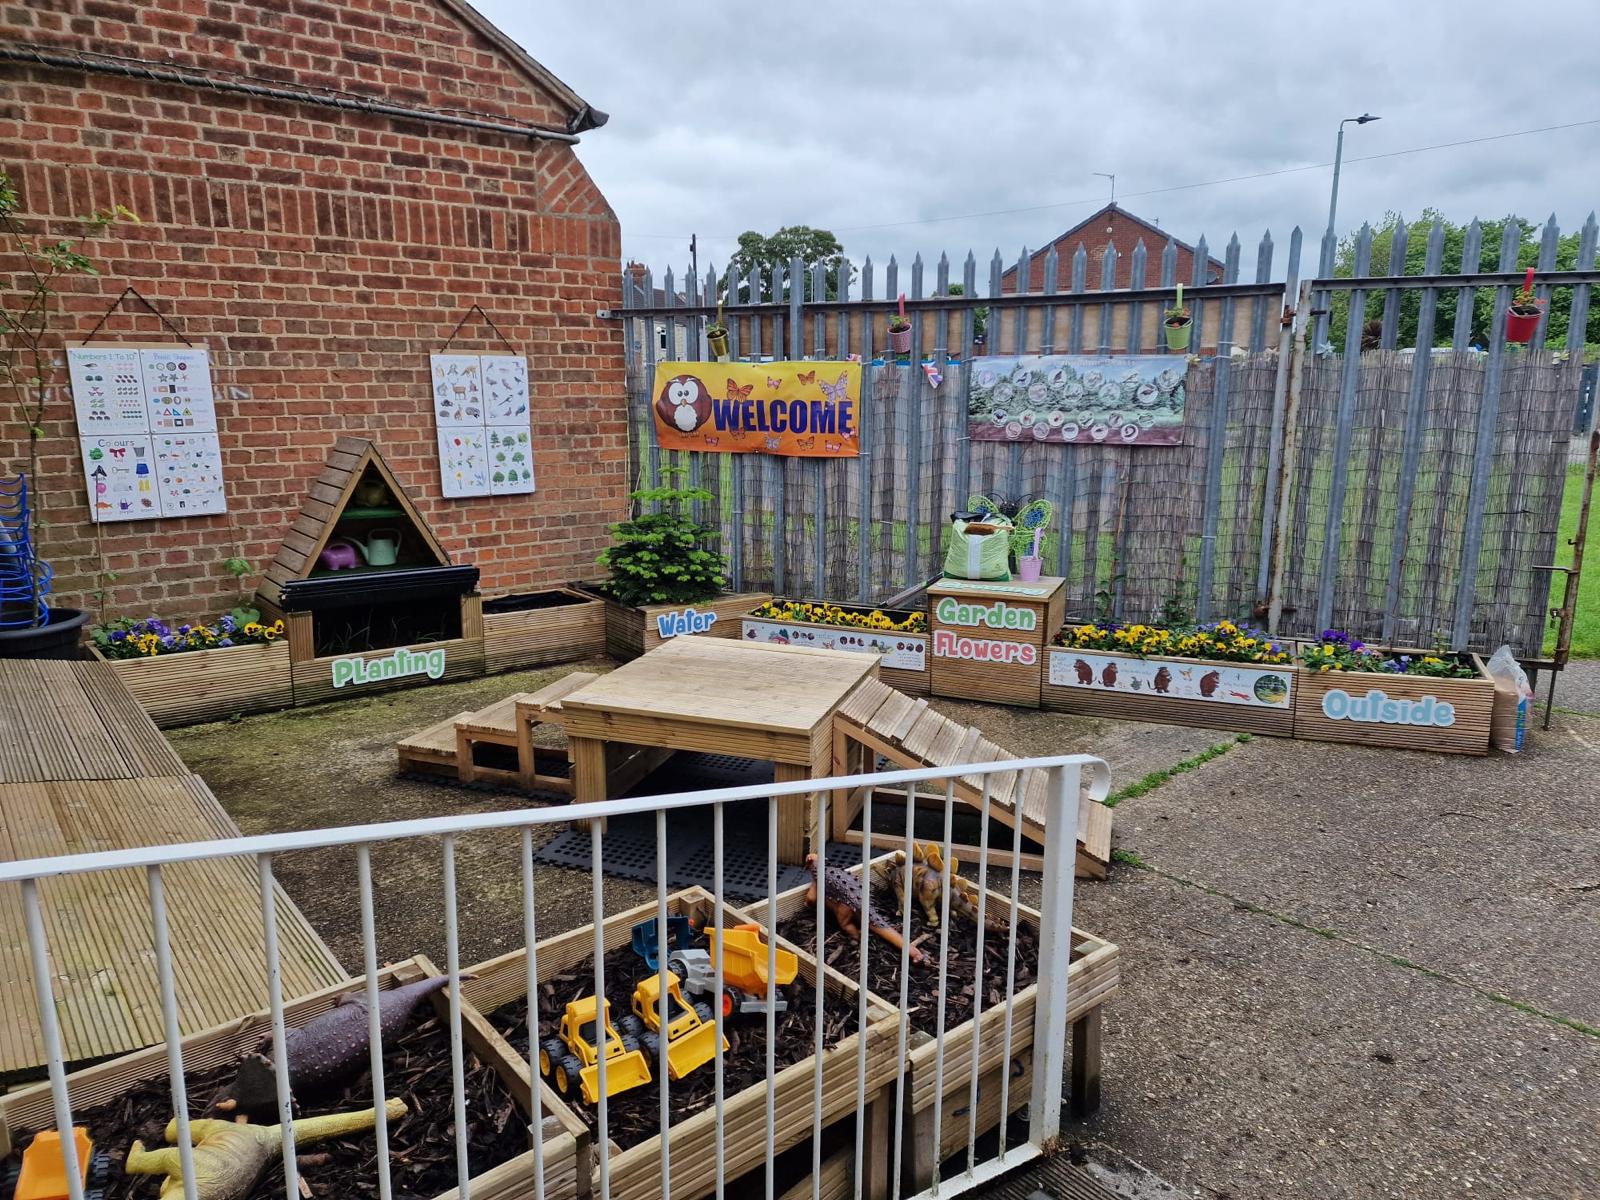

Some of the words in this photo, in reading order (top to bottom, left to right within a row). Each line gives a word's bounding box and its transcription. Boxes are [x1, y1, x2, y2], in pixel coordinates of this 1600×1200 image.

[73, 352, 107, 361] Numbers
[713, 399, 853, 434] WELCOME
[97, 438, 136, 448] Coours
[658, 609, 716, 636] Water
[938, 598, 1035, 629] Garden
[1324, 691, 1453, 724] Outside
